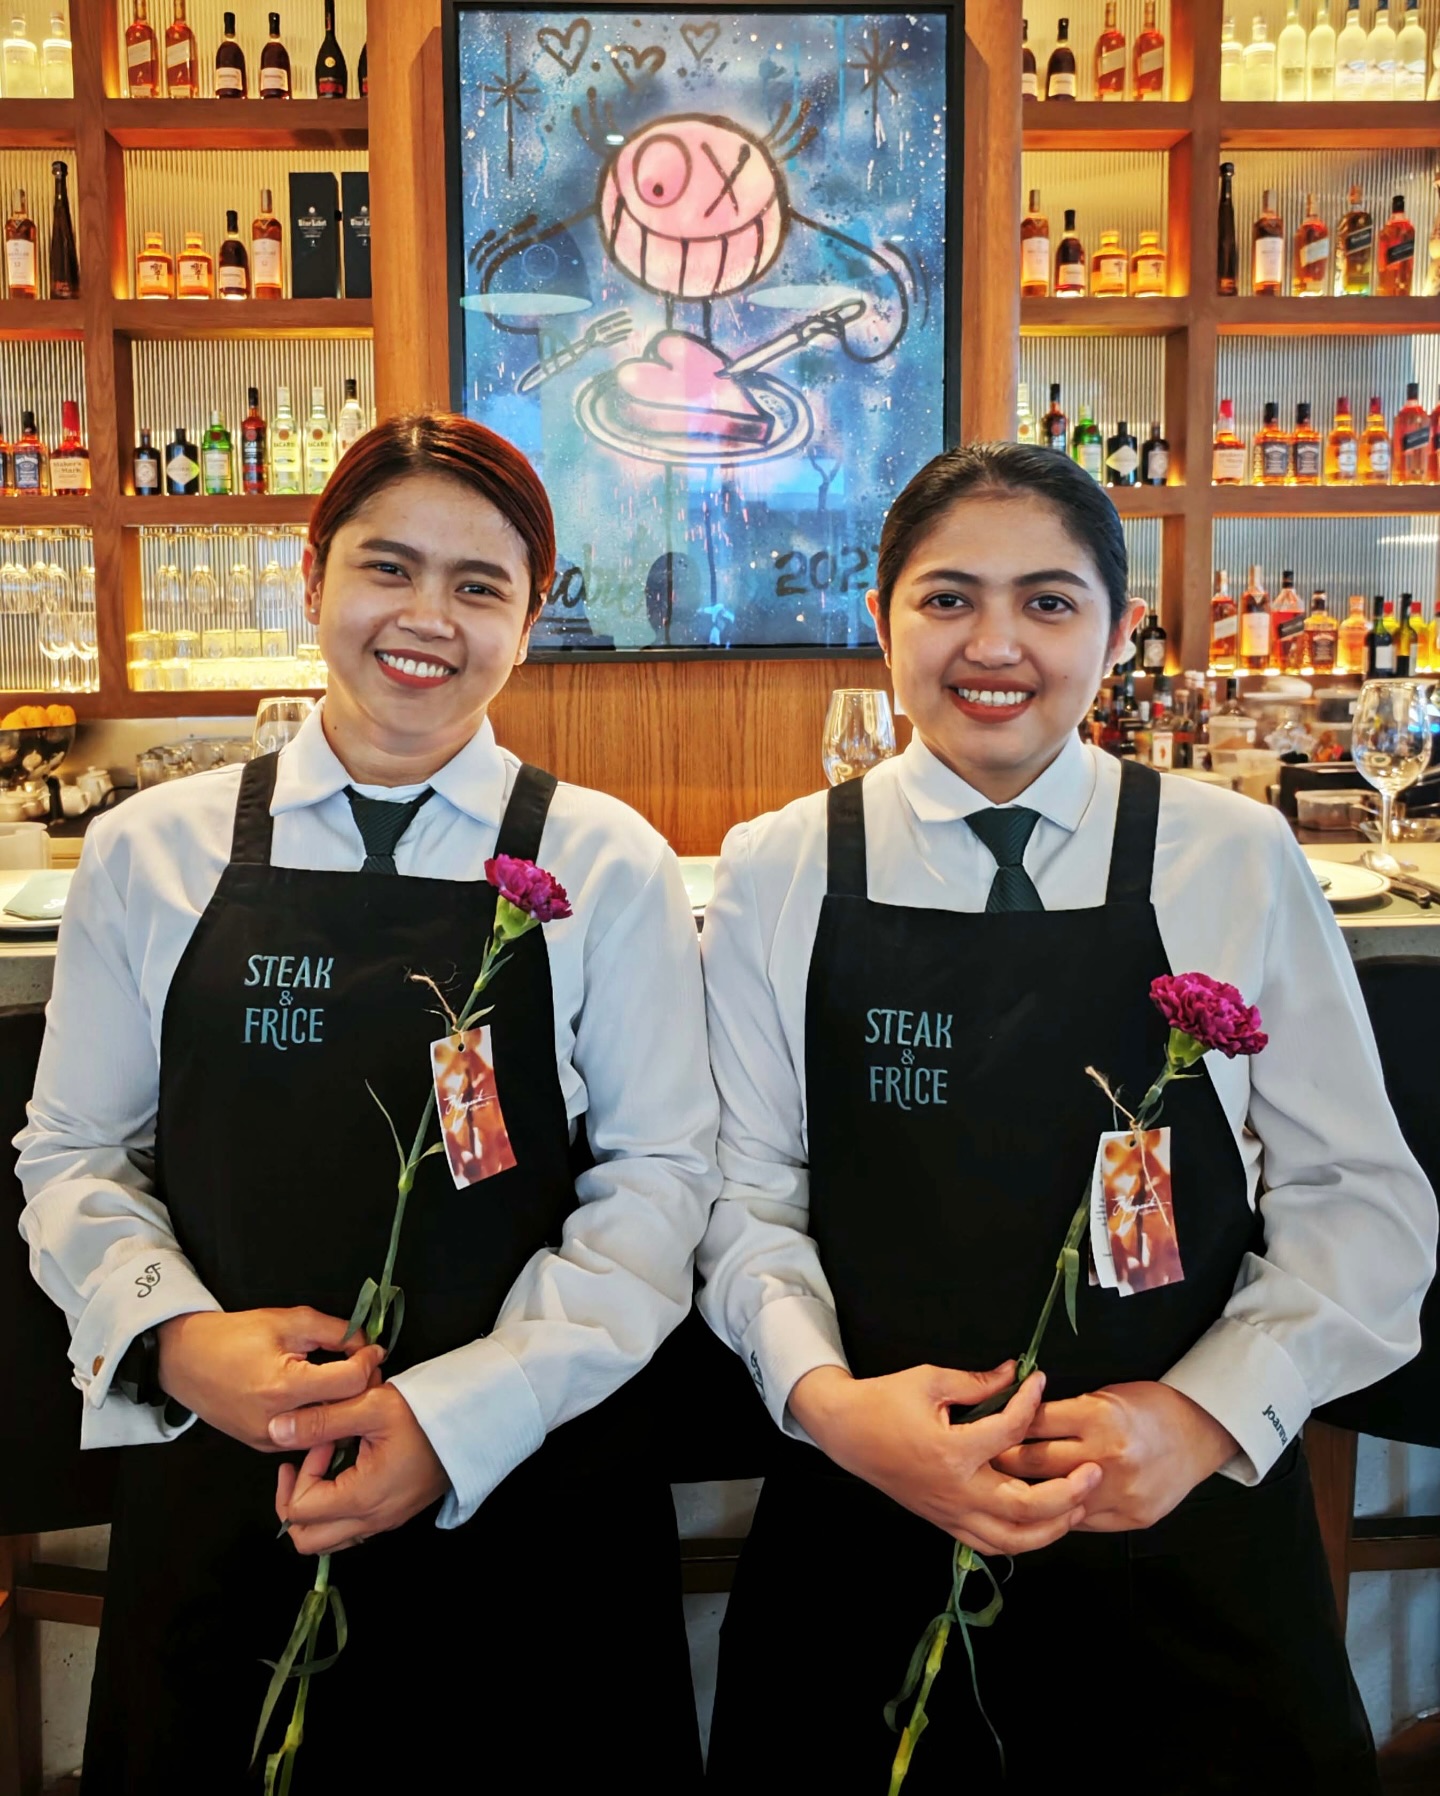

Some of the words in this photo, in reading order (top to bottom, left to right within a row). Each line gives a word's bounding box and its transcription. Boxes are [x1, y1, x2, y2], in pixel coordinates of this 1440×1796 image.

[243, 953, 335, 989] STEAK
[278, 990, 294, 1006] &
[242, 1007, 325, 1051] FRICE
[864, 1008, 953, 1049] STEAK
[900, 1048, 916, 1065] &
[869, 1066, 949, 1111] FRICE
